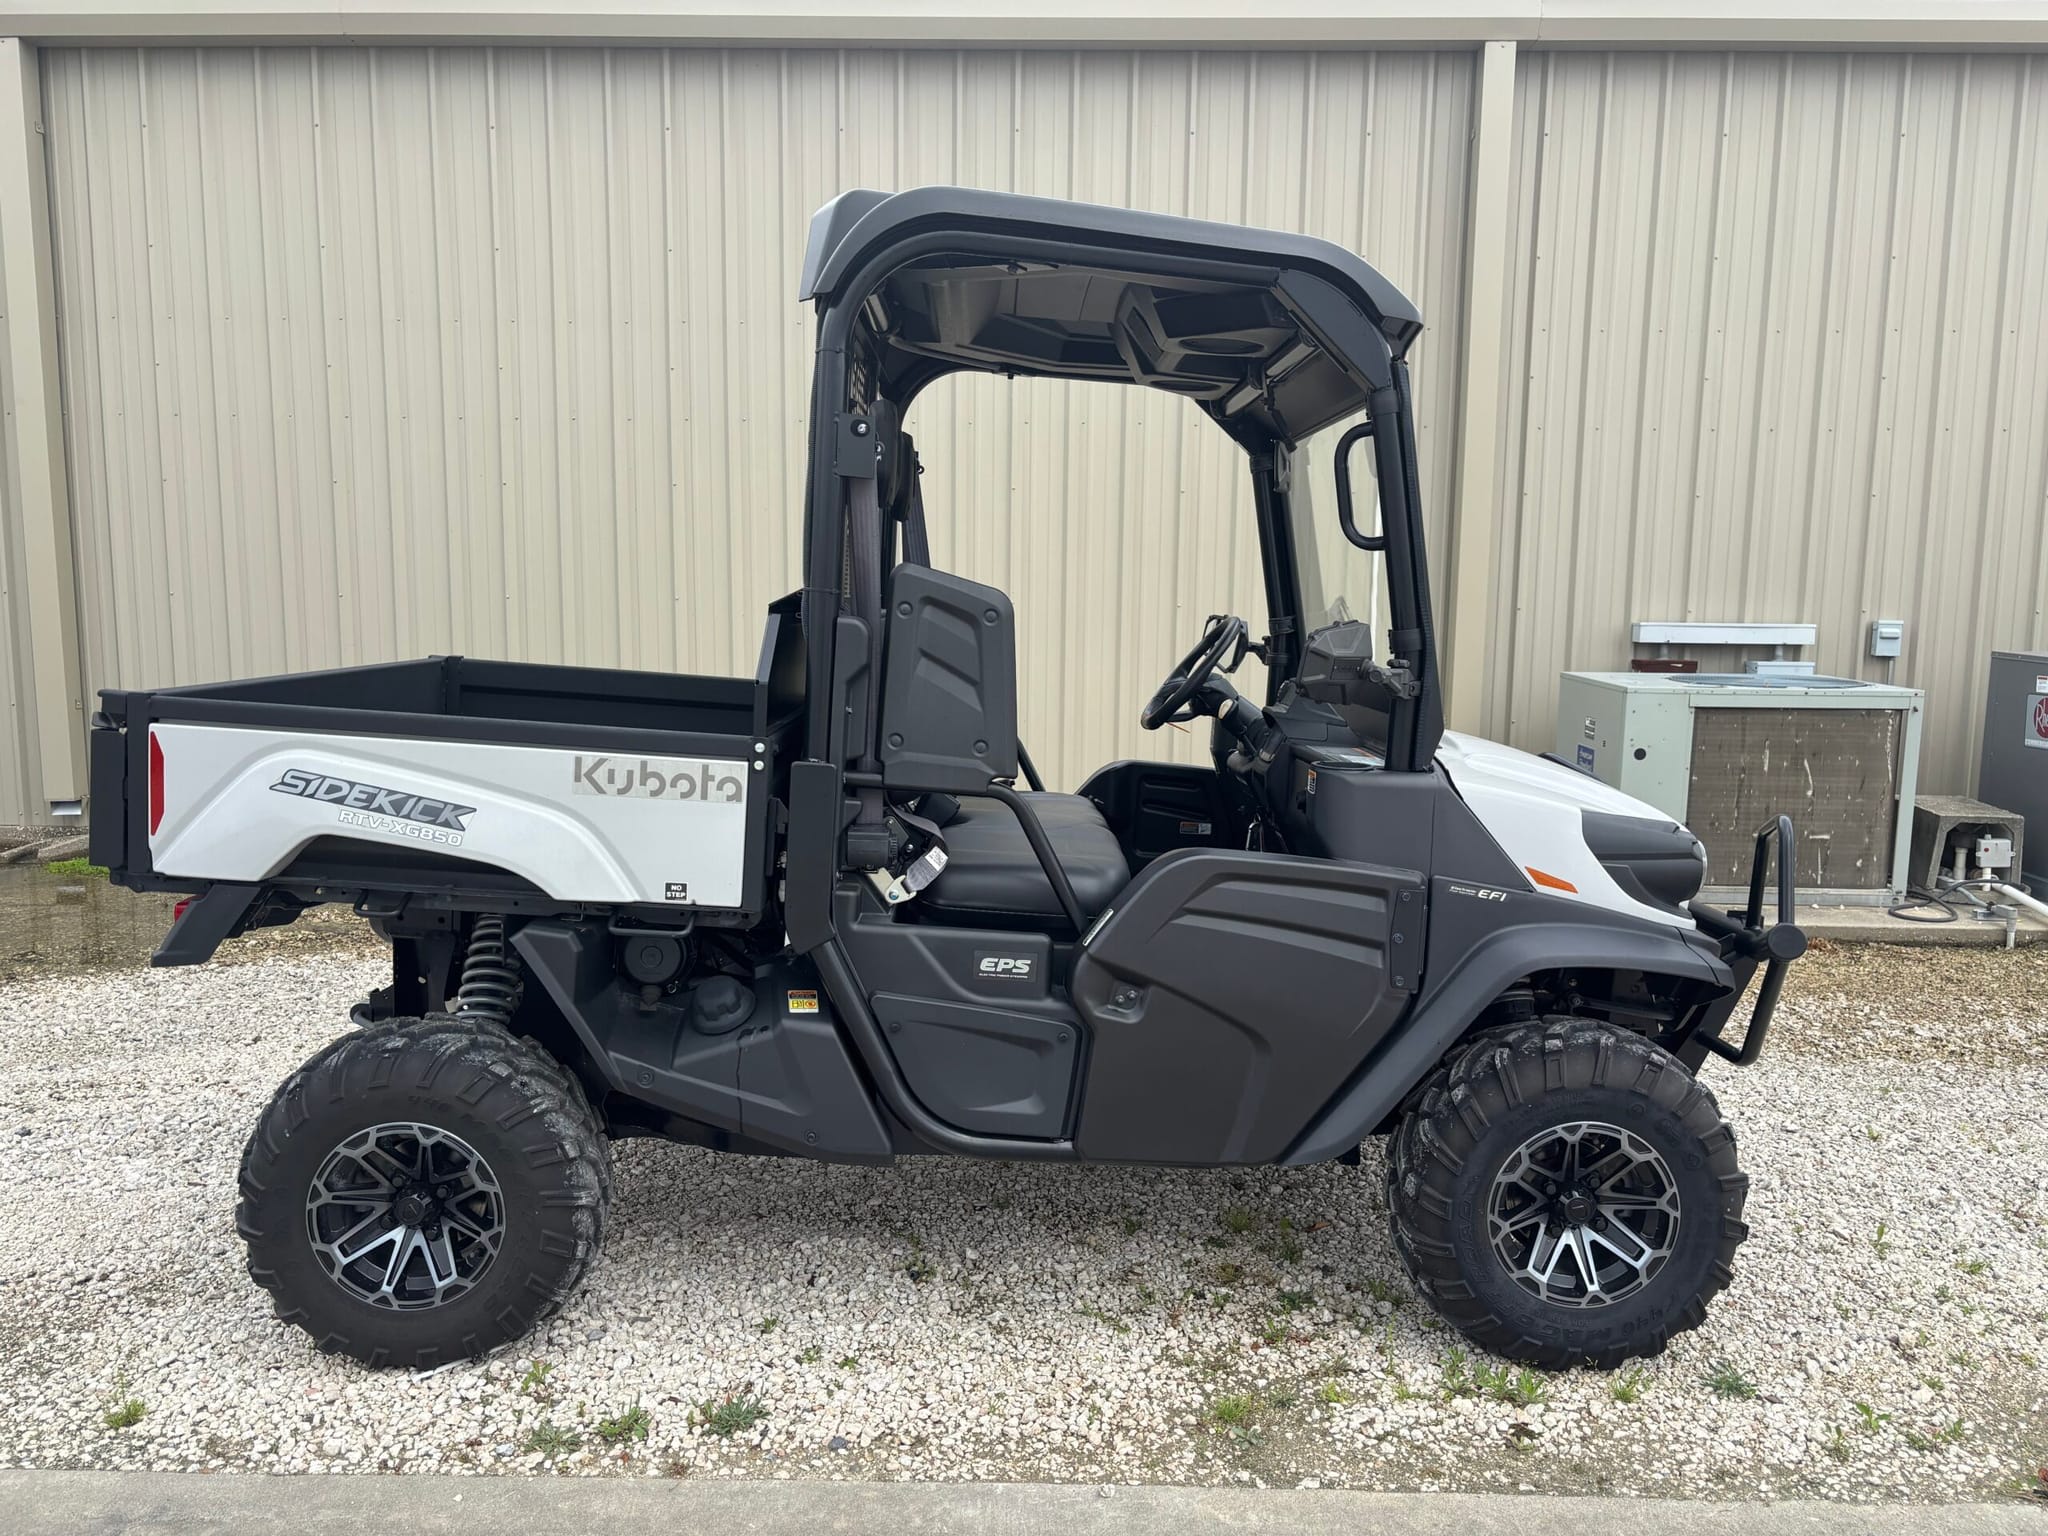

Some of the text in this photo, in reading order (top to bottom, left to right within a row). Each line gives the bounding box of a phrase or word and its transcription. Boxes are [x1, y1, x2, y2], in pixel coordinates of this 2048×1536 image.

[574, 756, 743, 803] Kubota
[269, 769, 477, 831] SIDEKICK
[338, 809, 464, 847] RTV-XG850
[1478, 889, 1507, 901] EFI
[980, 957, 1031, 974] EPS
